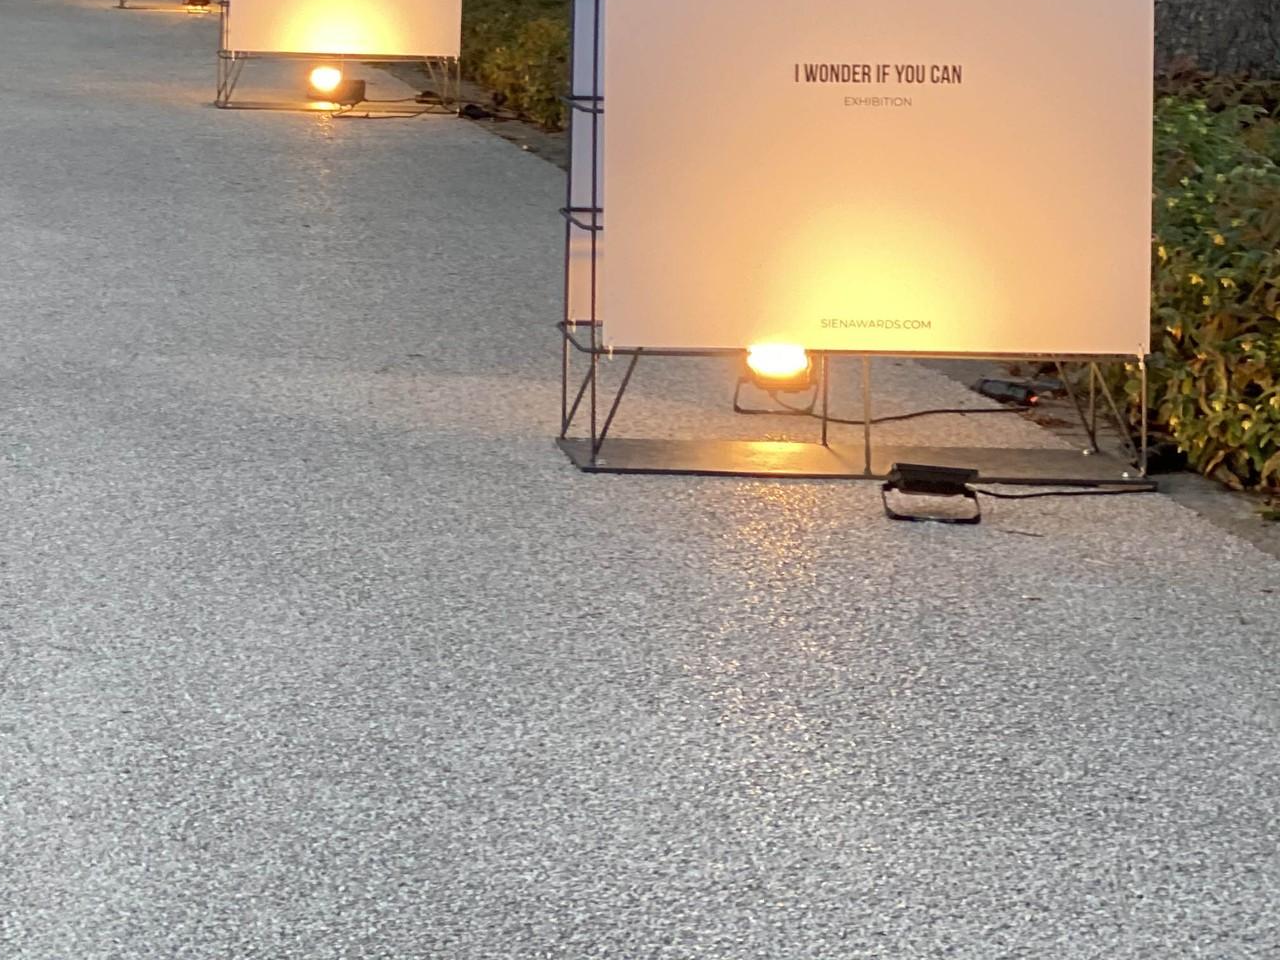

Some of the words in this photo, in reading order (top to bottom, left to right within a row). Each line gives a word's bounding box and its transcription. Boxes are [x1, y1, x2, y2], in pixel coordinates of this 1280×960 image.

[795, 63, 799, 83] I
[804, 63, 871, 84] WONDER
[876, 64, 891, 84] IF
[894, 64, 926, 84] YOU
[930, 65, 962, 85] CAN
[844, 96, 913, 107] EXHIBITION
[820, 318, 932, 330] SIENAWARDS.COM
